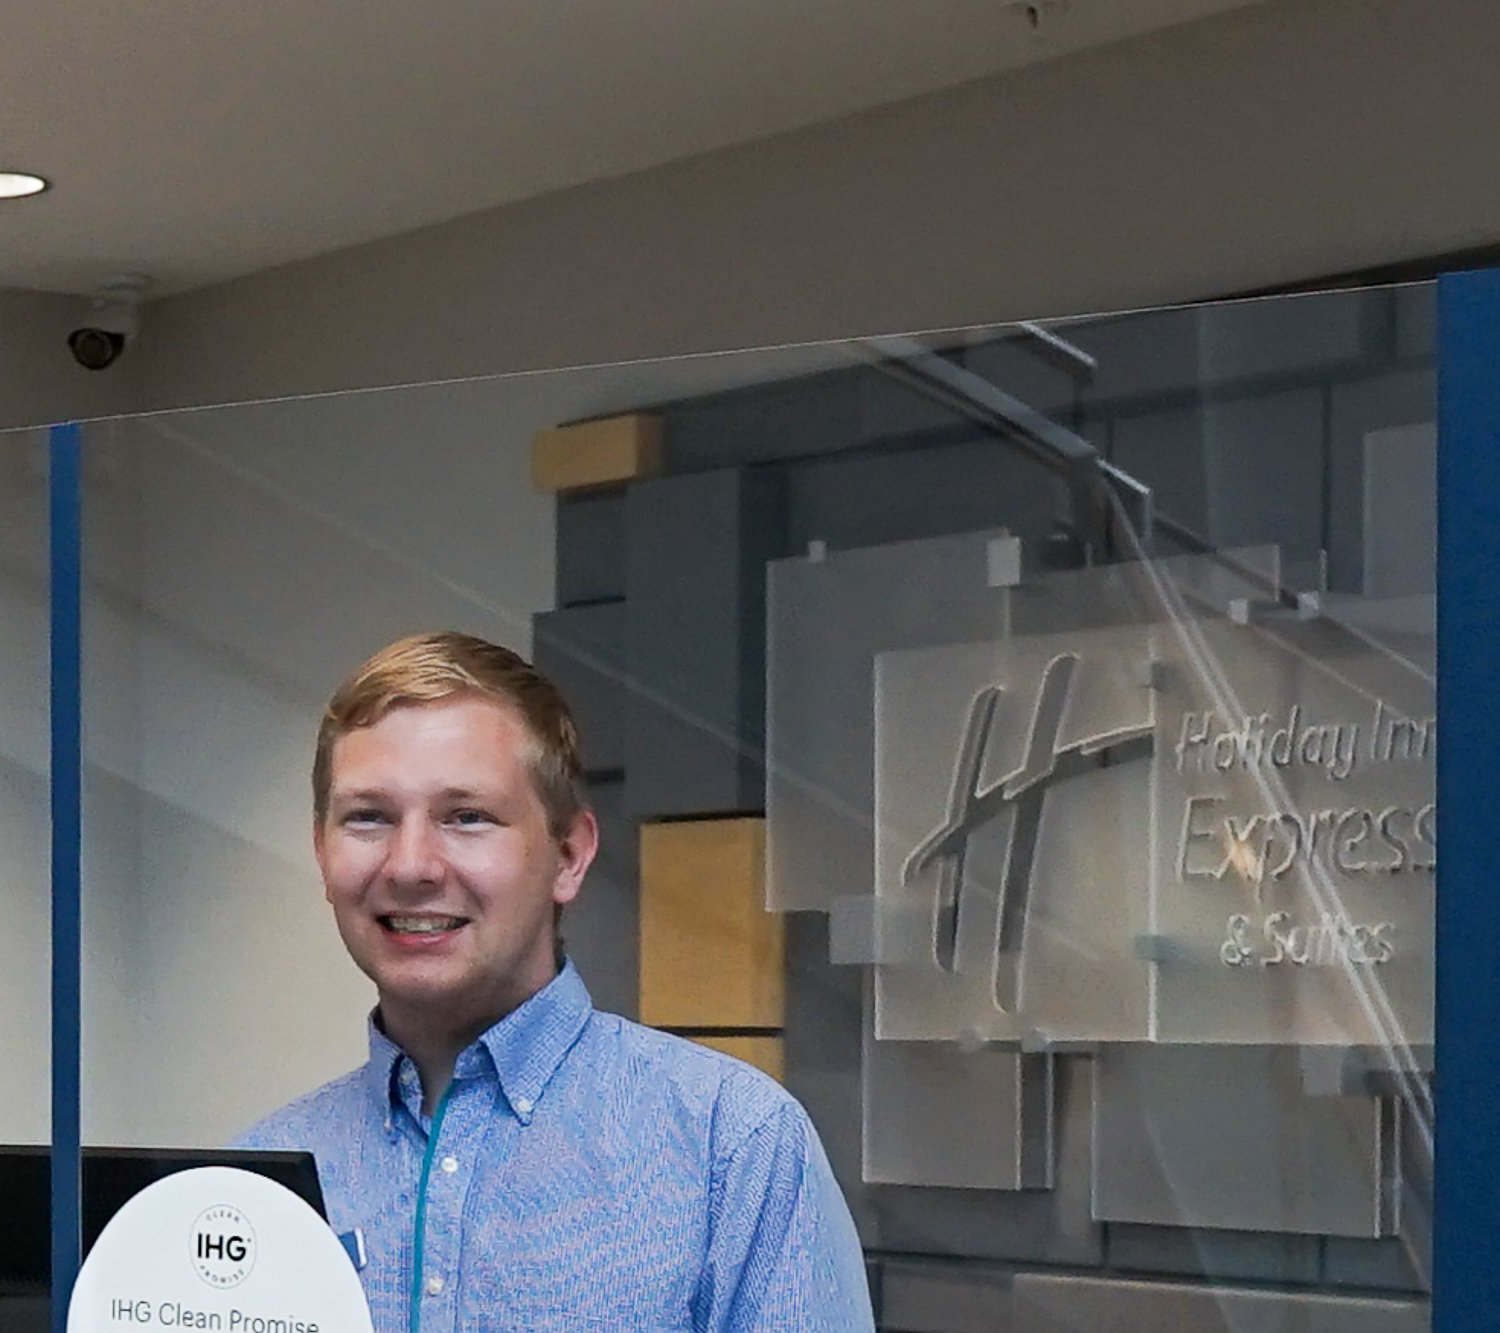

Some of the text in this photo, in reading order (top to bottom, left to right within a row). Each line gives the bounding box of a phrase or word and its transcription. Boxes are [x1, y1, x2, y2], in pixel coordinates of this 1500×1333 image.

[1176, 704, 1357, 780] Holiday
[1175, 796, 1436, 903] Express
[1220, 911, 1395, 967] & Suites
[197, 1232, 247, 1262] IHG
[111, 1299, 151, 1323] IHG
[158, 1302, 221, 1331] Clean
